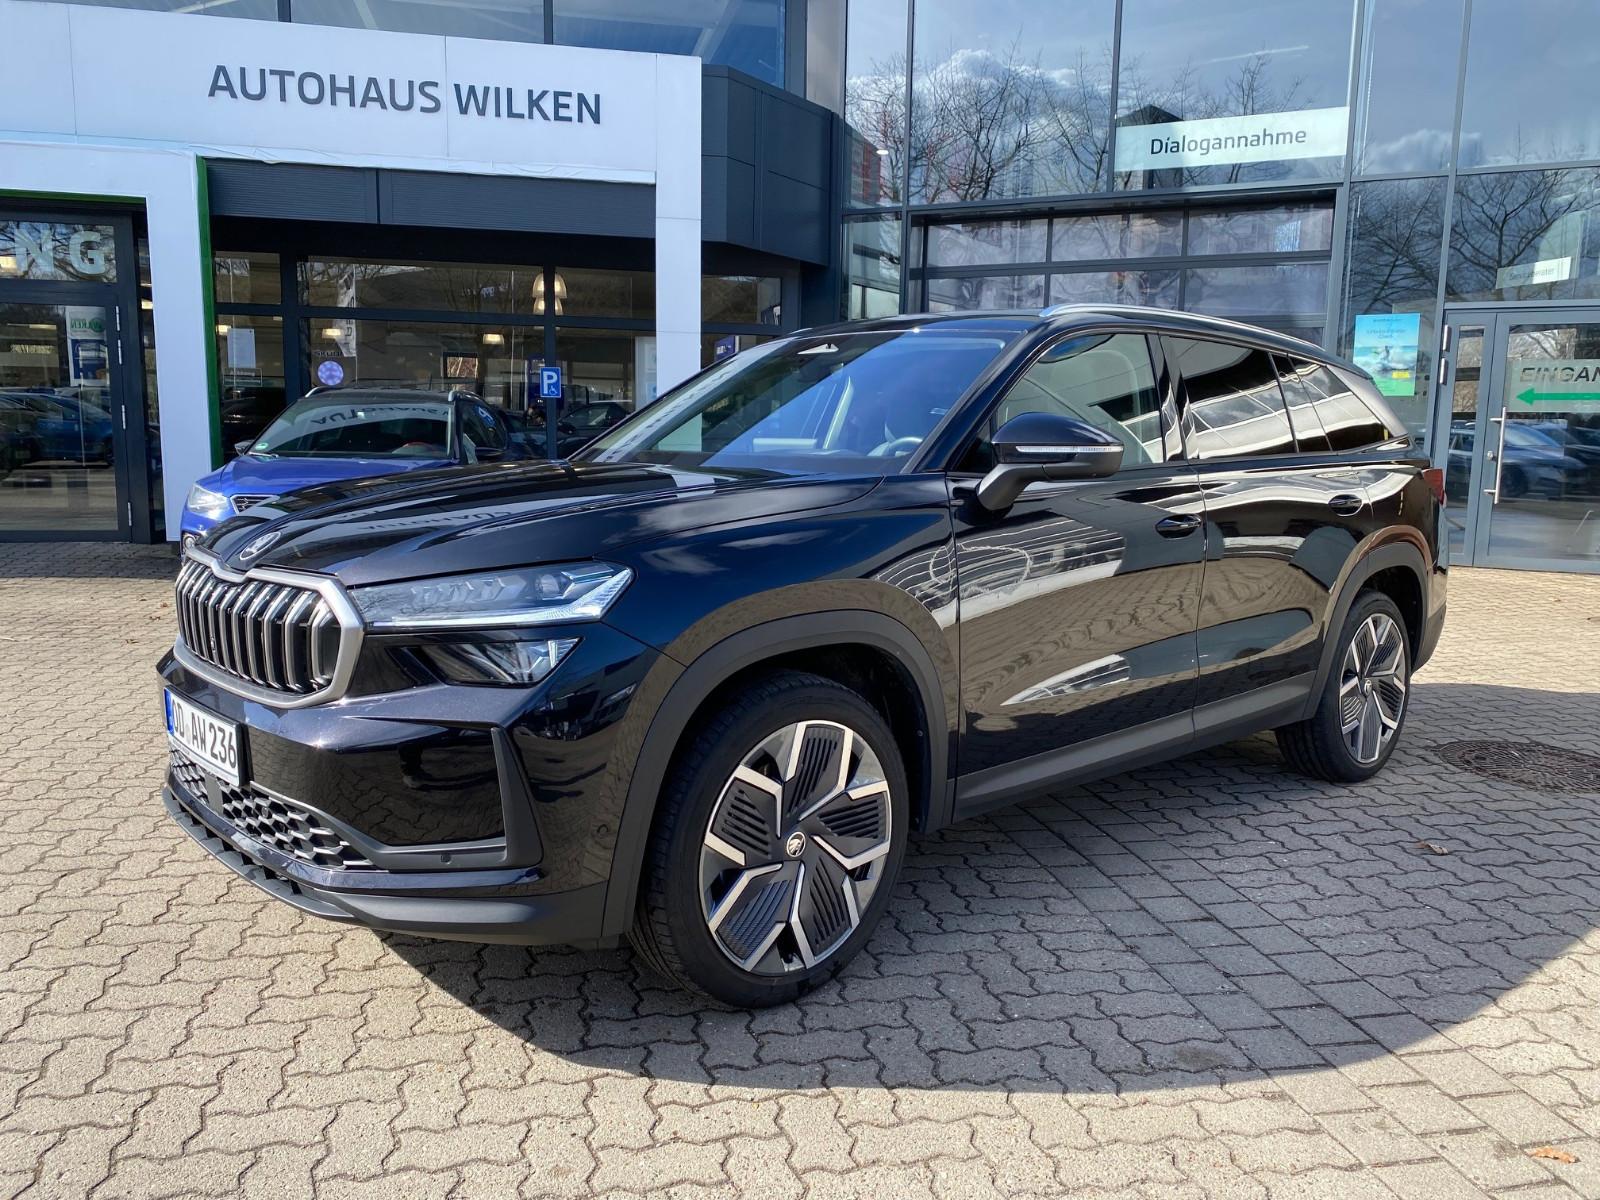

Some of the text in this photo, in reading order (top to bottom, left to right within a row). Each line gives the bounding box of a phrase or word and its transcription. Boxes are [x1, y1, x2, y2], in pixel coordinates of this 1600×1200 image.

[207, 64, 601, 125] AUTOHAUS WILKEN
[1150, 127, 1307, 156] Dialogannahme
[543, 371, 558, 394] P
[191, 711, 207, 754] AW
[208, 721, 237, 769] 236
